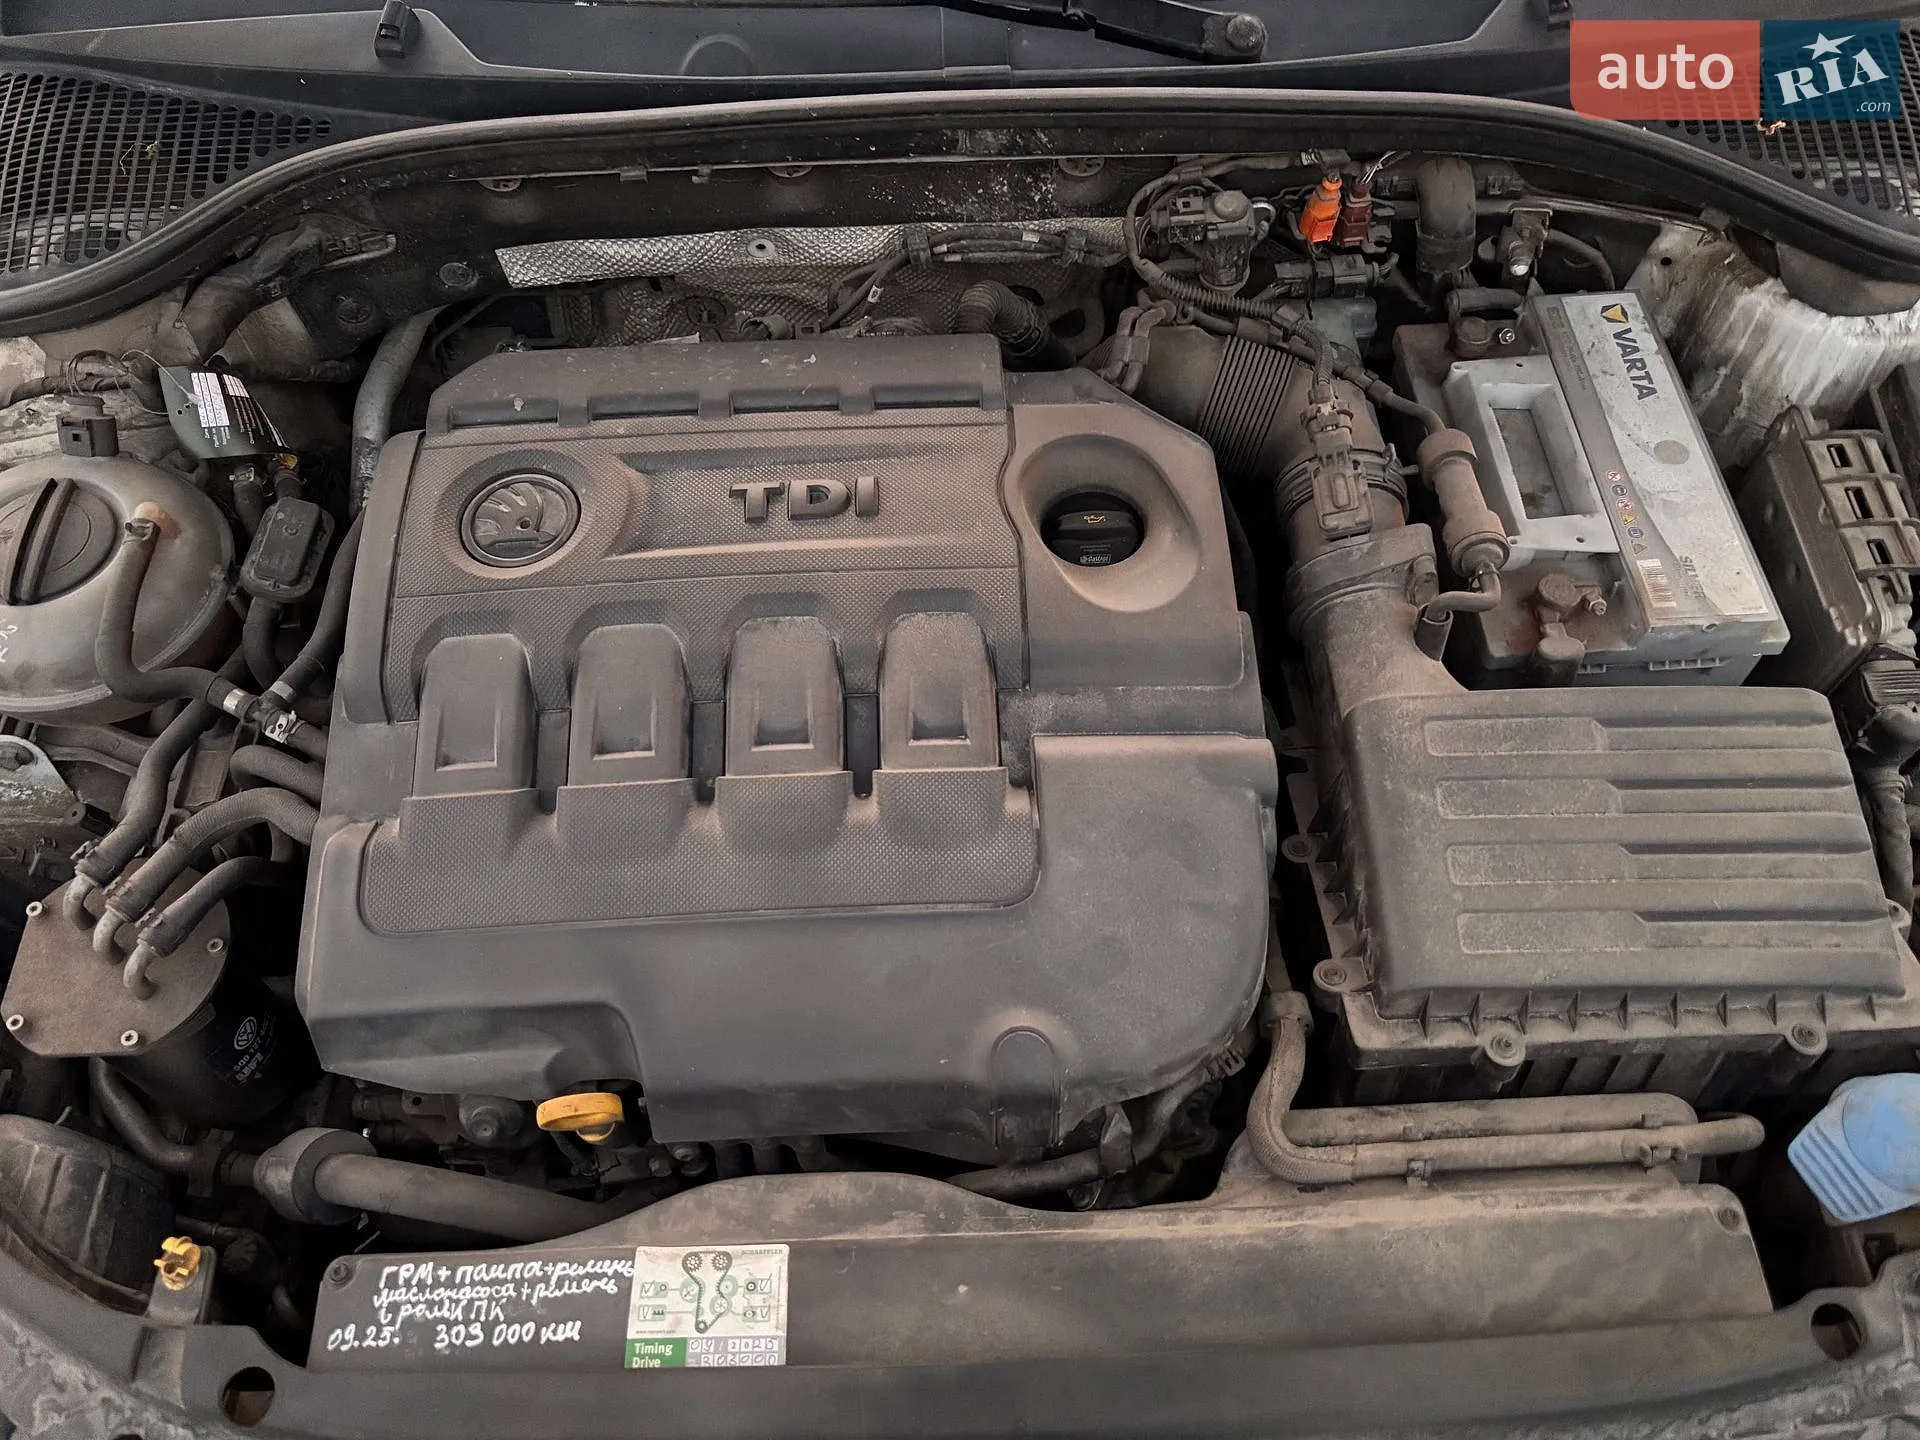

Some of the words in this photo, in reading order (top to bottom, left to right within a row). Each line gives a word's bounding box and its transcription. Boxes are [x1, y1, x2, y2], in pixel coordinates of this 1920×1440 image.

[1612, 327, 1658, 401] VARTA
[729, 475, 880, 523] TDI
[379, 1261, 434, 1289] ГРМ
[632, 1356, 661, 1368] Drive
[634, 1342, 673, 1355] Timing
